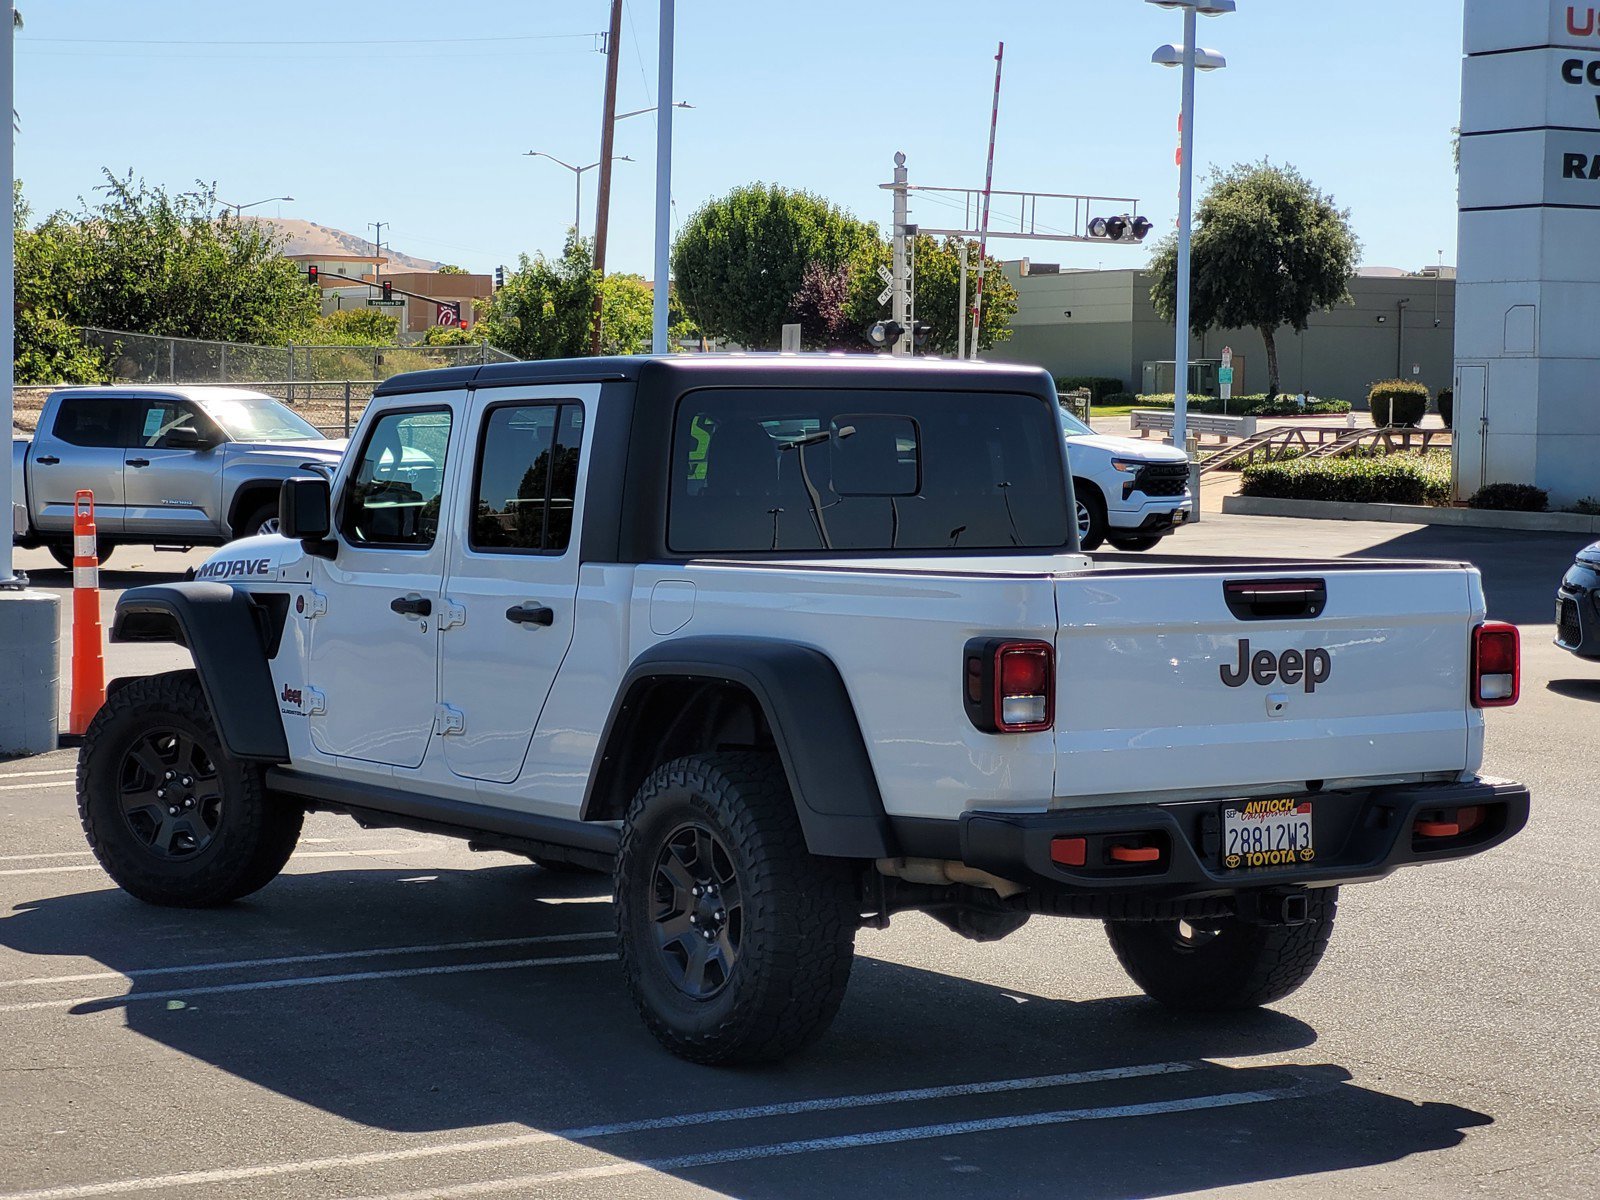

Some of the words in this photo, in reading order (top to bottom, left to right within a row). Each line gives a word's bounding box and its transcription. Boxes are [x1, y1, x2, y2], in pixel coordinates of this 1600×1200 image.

[198, 558, 271, 579] MOJAVE
[1219, 638, 1331, 693] Jeep
[281, 683, 302, 708] Jeep
[1226, 810, 1237, 819] SEP
[1245, 798, 1295, 814] ANTIOCH
[1229, 822, 1309, 855] 28812W3
[1246, 849, 1296, 866] TOYOTA
